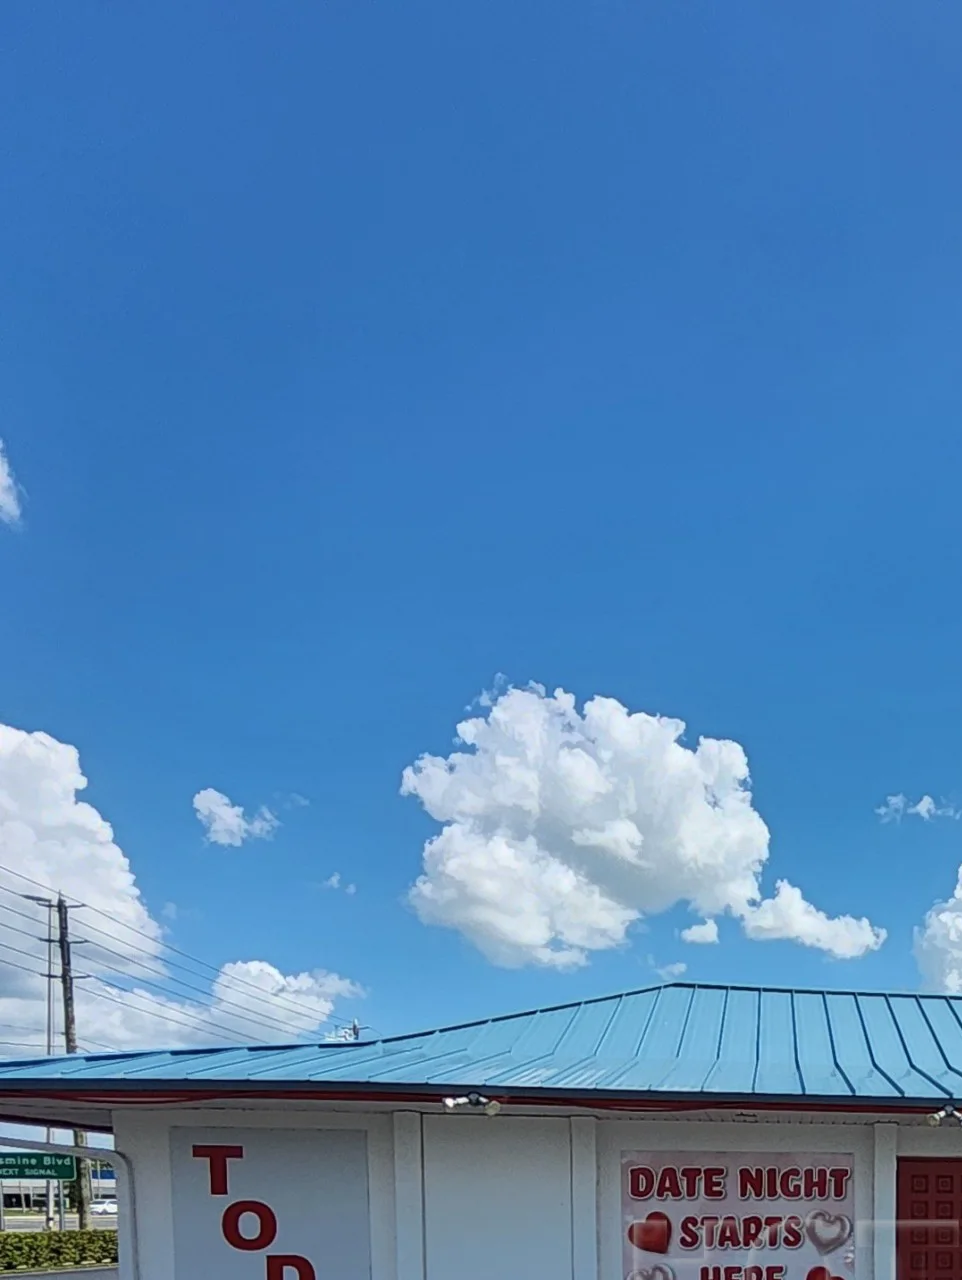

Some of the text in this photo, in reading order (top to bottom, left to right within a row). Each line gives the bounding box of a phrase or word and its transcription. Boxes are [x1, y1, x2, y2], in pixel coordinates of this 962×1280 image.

[43, 1156, 71, 1165] Blvd
[24, 1168, 58, 1176] SIGNAL
[629, 1167, 850, 1199] DATE NIGHT
[678, 1215, 804, 1249] STARTS
